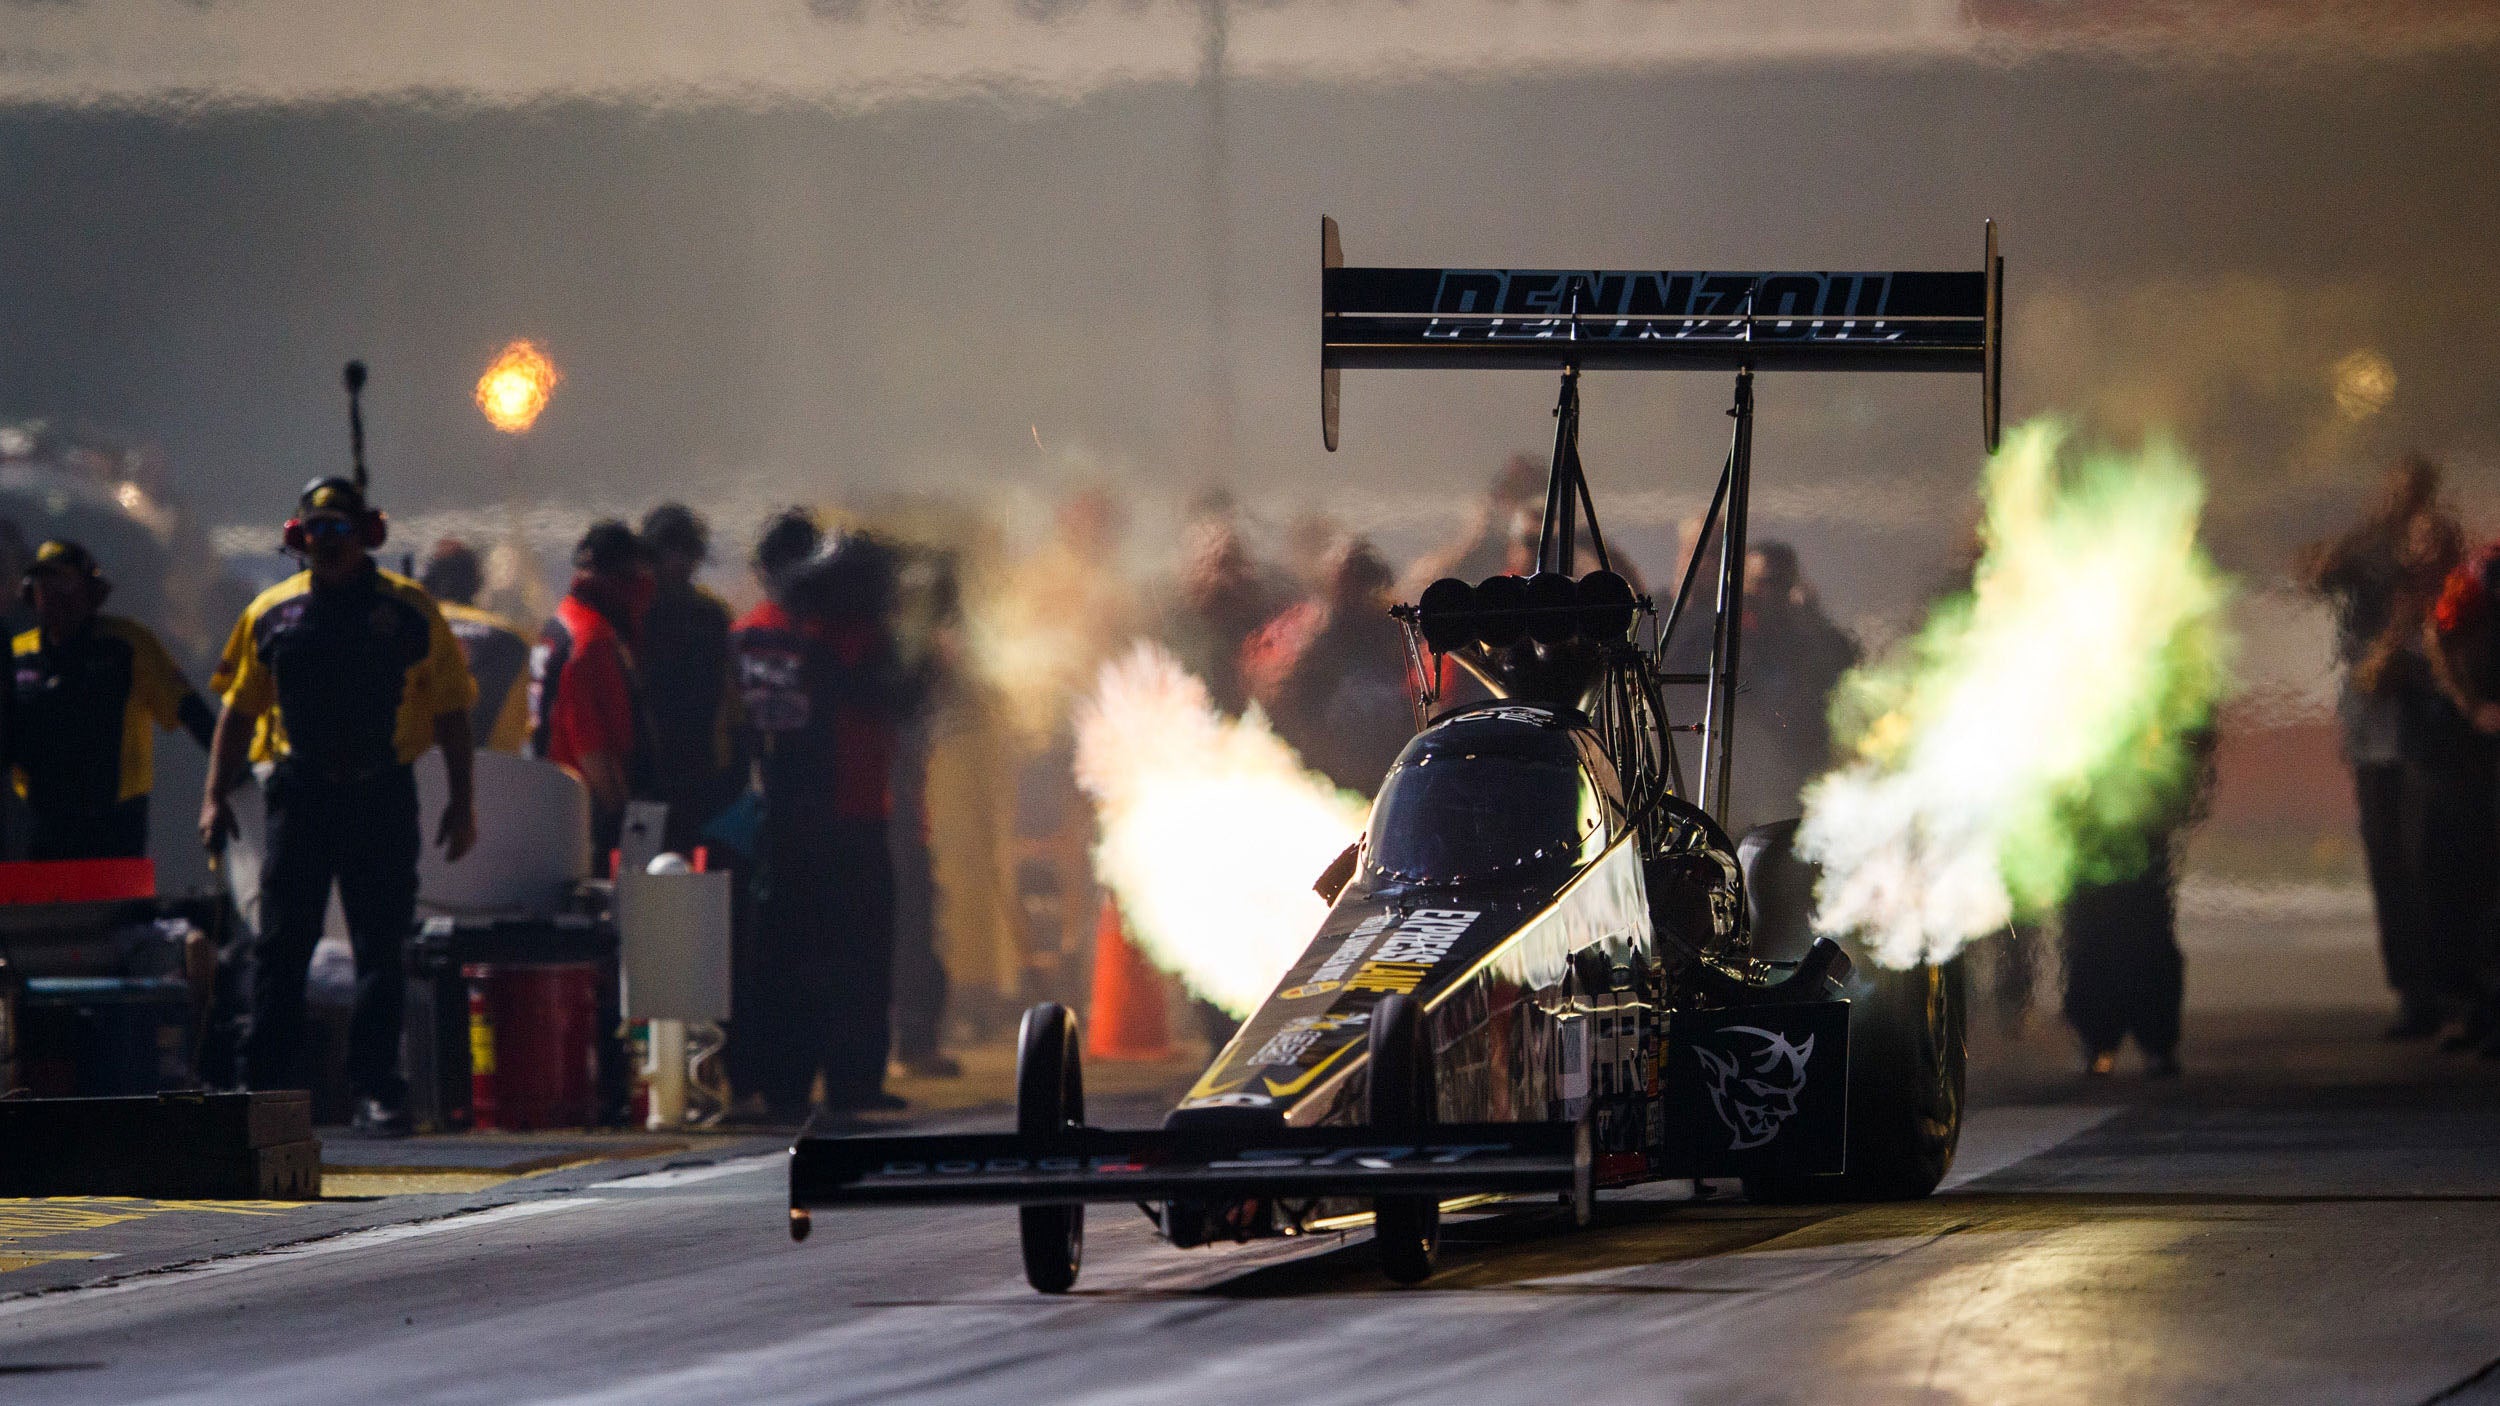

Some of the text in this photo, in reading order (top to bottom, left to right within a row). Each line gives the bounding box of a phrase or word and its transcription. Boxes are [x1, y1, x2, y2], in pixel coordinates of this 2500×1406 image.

[1422, 269, 1905, 342] PENNZOIL
[1369, 908, 1481, 964] EXPRESS
[1340, 961, 1435, 995] LANE
